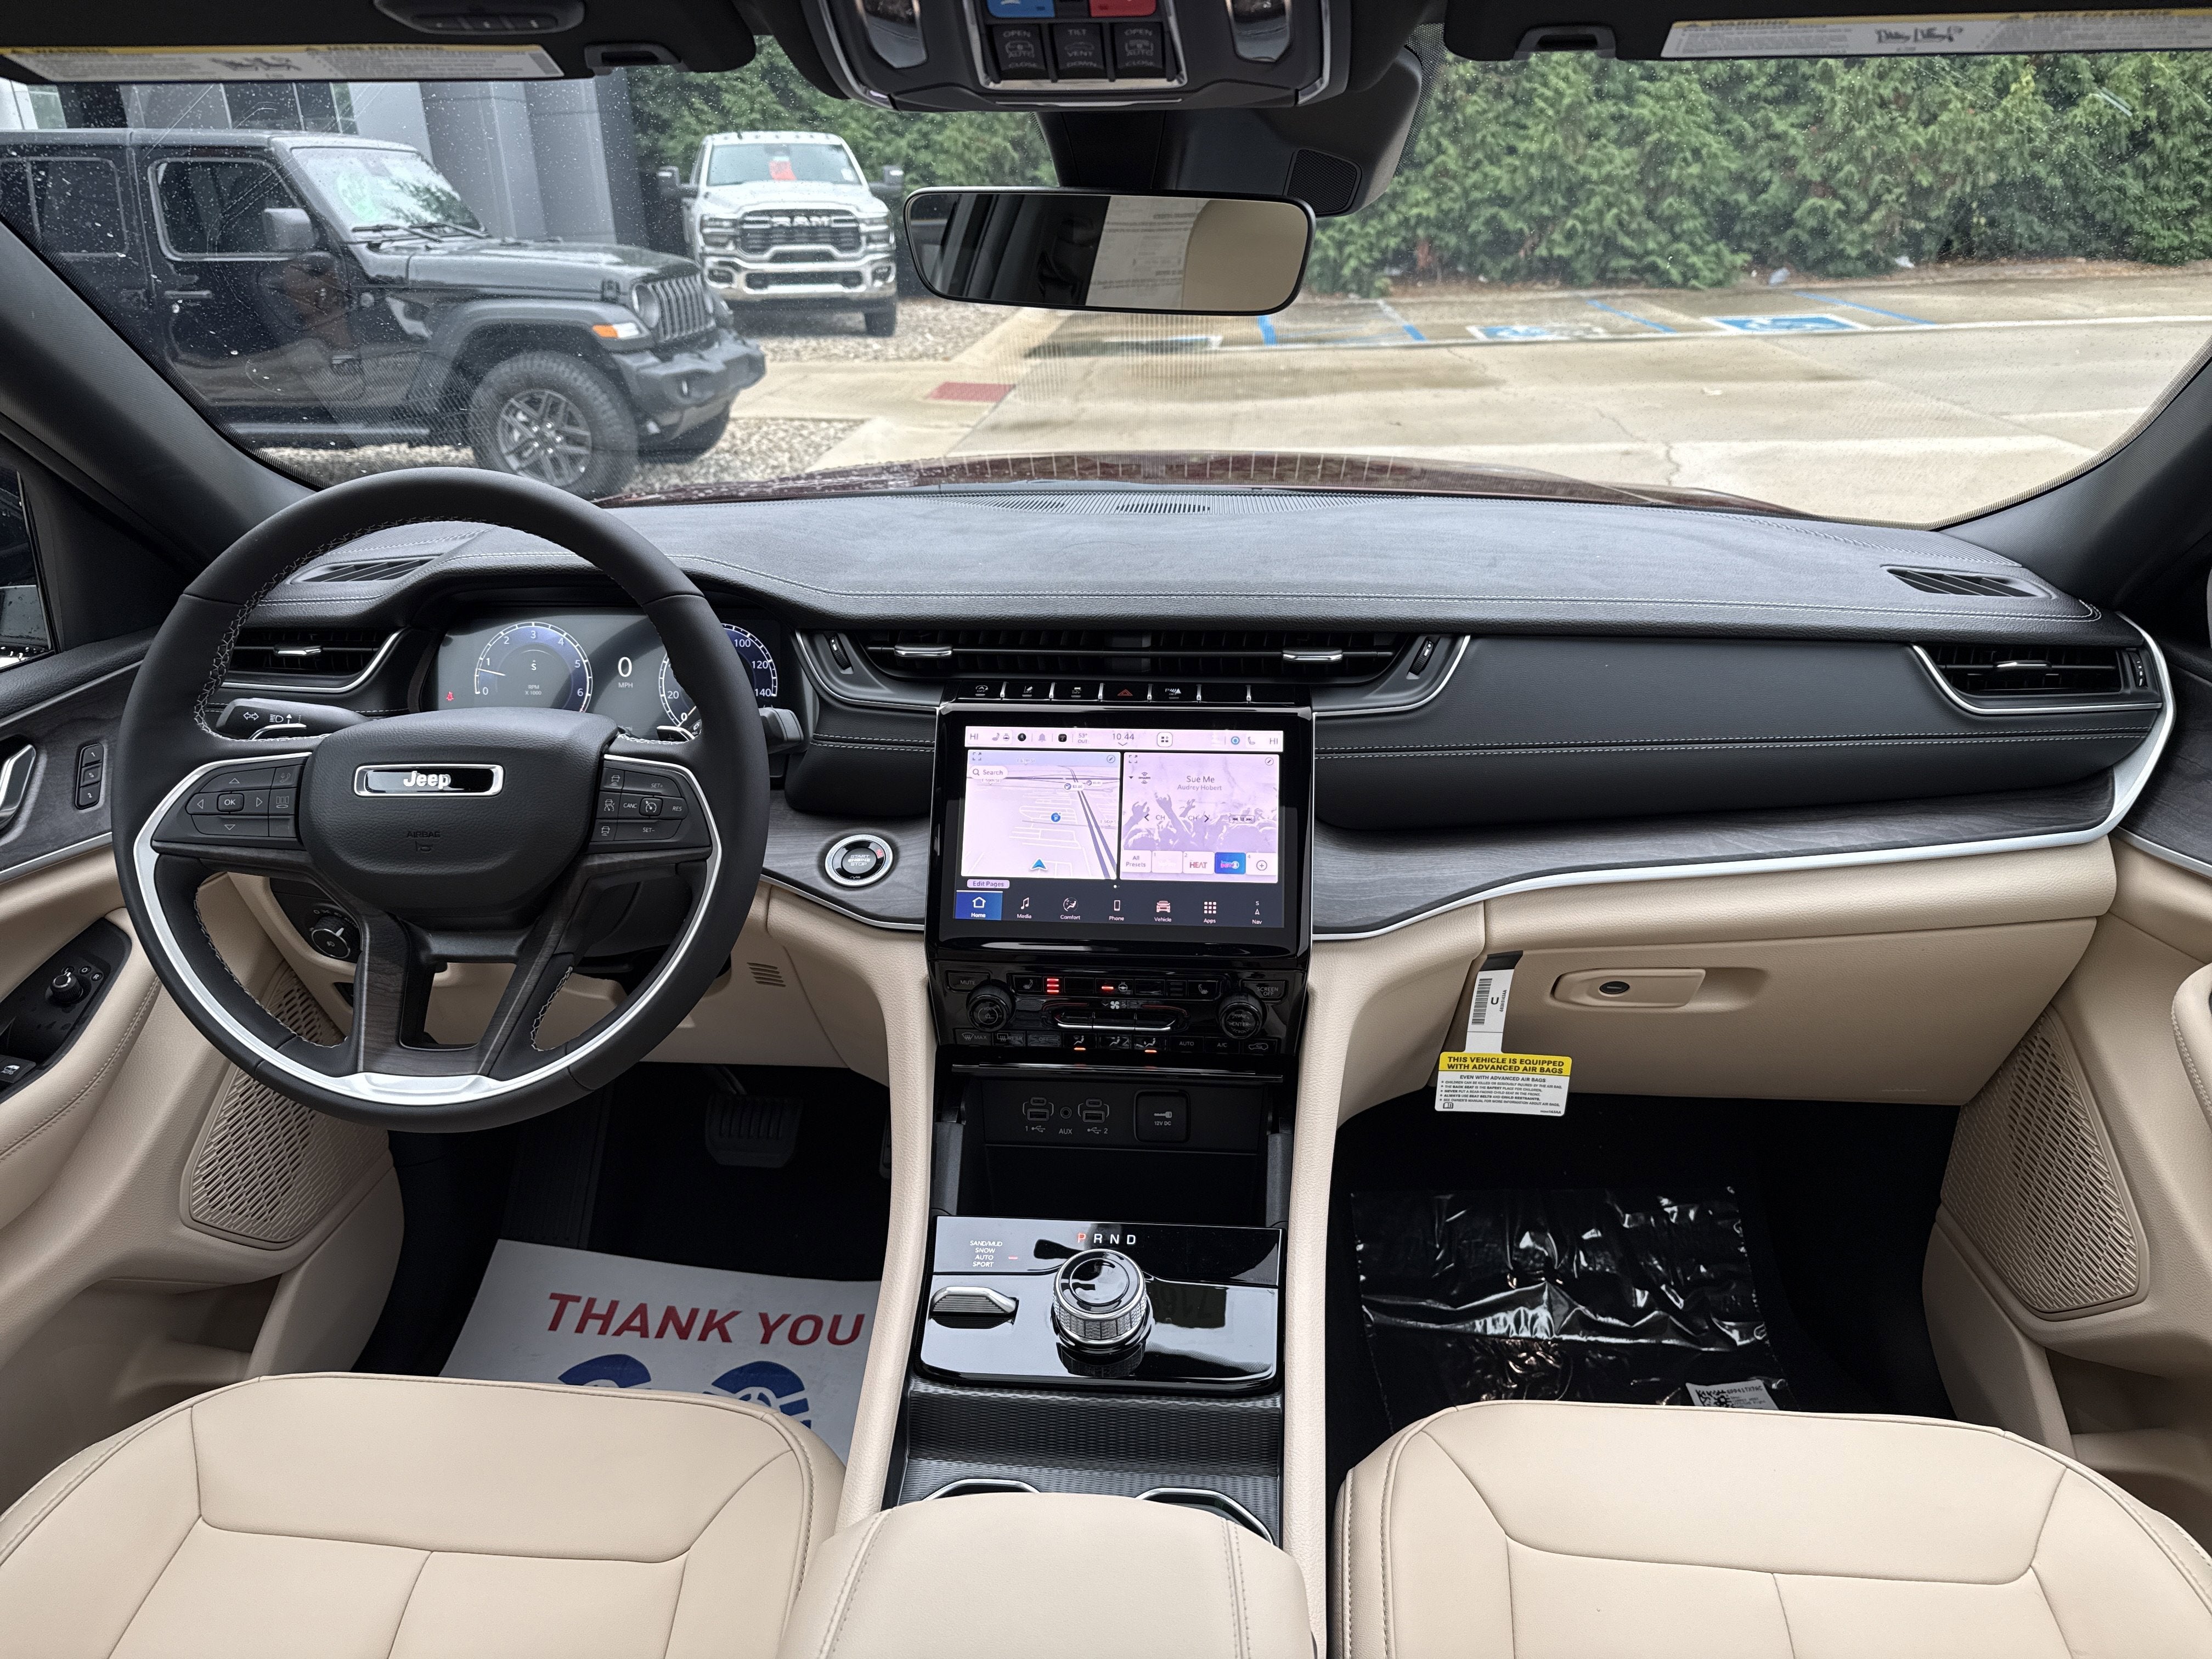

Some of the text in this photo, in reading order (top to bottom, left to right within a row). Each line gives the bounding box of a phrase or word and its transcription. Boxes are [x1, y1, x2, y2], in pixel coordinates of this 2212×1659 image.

[772, 216, 830, 227] RAM
[504, 636, 510, 645] 2
[734, 639, 751, 647] 100
[618, 657, 632, 677] 0
[752, 661, 768, 669] 120
[483, 687, 489, 695] 0
[577, 688, 583, 696] 6
[667, 691, 679, 699] 20
[754, 689, 771, 697] 140
[681, 712, 687, 721] 0
[403, 770, 452, 789] Jeep
[548, 1293, 866, 1346] THANK YOU
